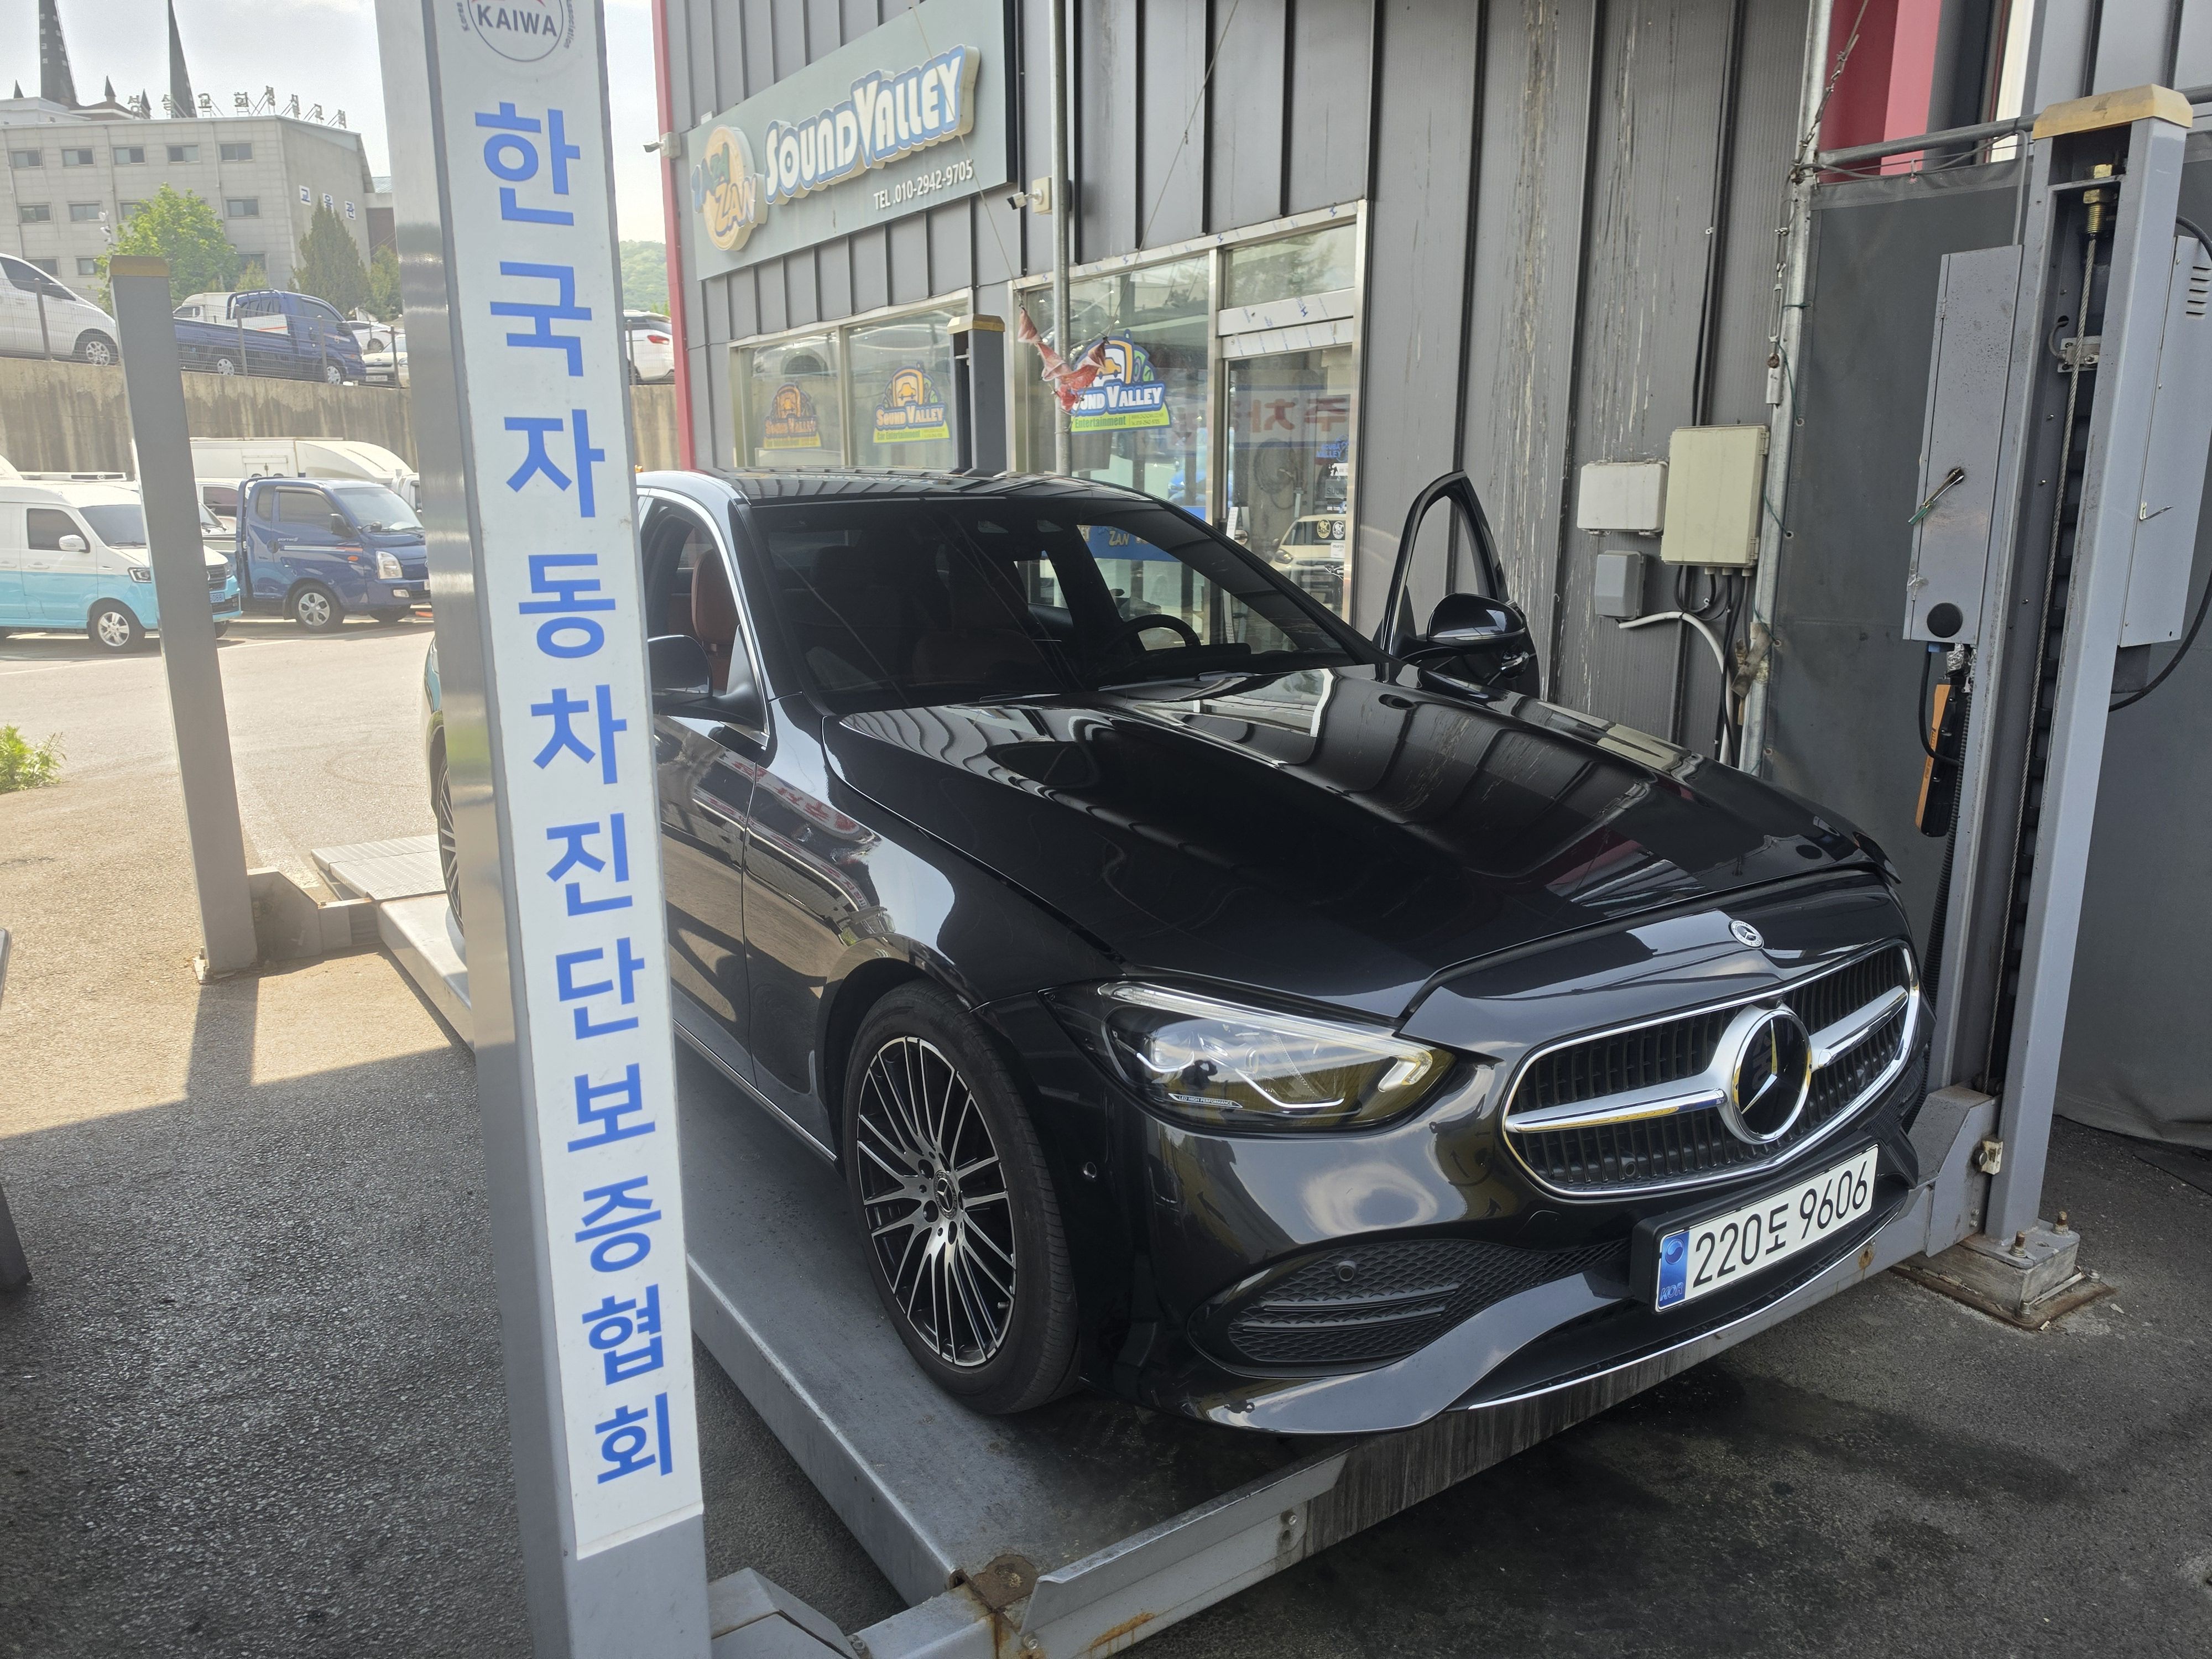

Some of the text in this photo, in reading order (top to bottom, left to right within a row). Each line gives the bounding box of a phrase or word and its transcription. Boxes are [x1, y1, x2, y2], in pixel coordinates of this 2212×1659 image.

[477, 4, 557, 36] KAIWA
[1106, 385, 1162, 408] VALLEY
[906, 405, 943, 424] VALLEY
[1075, 415, 1126, 429] Entertainment
[475, 101, 673, 1484] 한국자동차진단보증협회
[1693, 1160, 1867, 1288] 220도 9606
[1660, 1282, 1684, 1302] KOR
